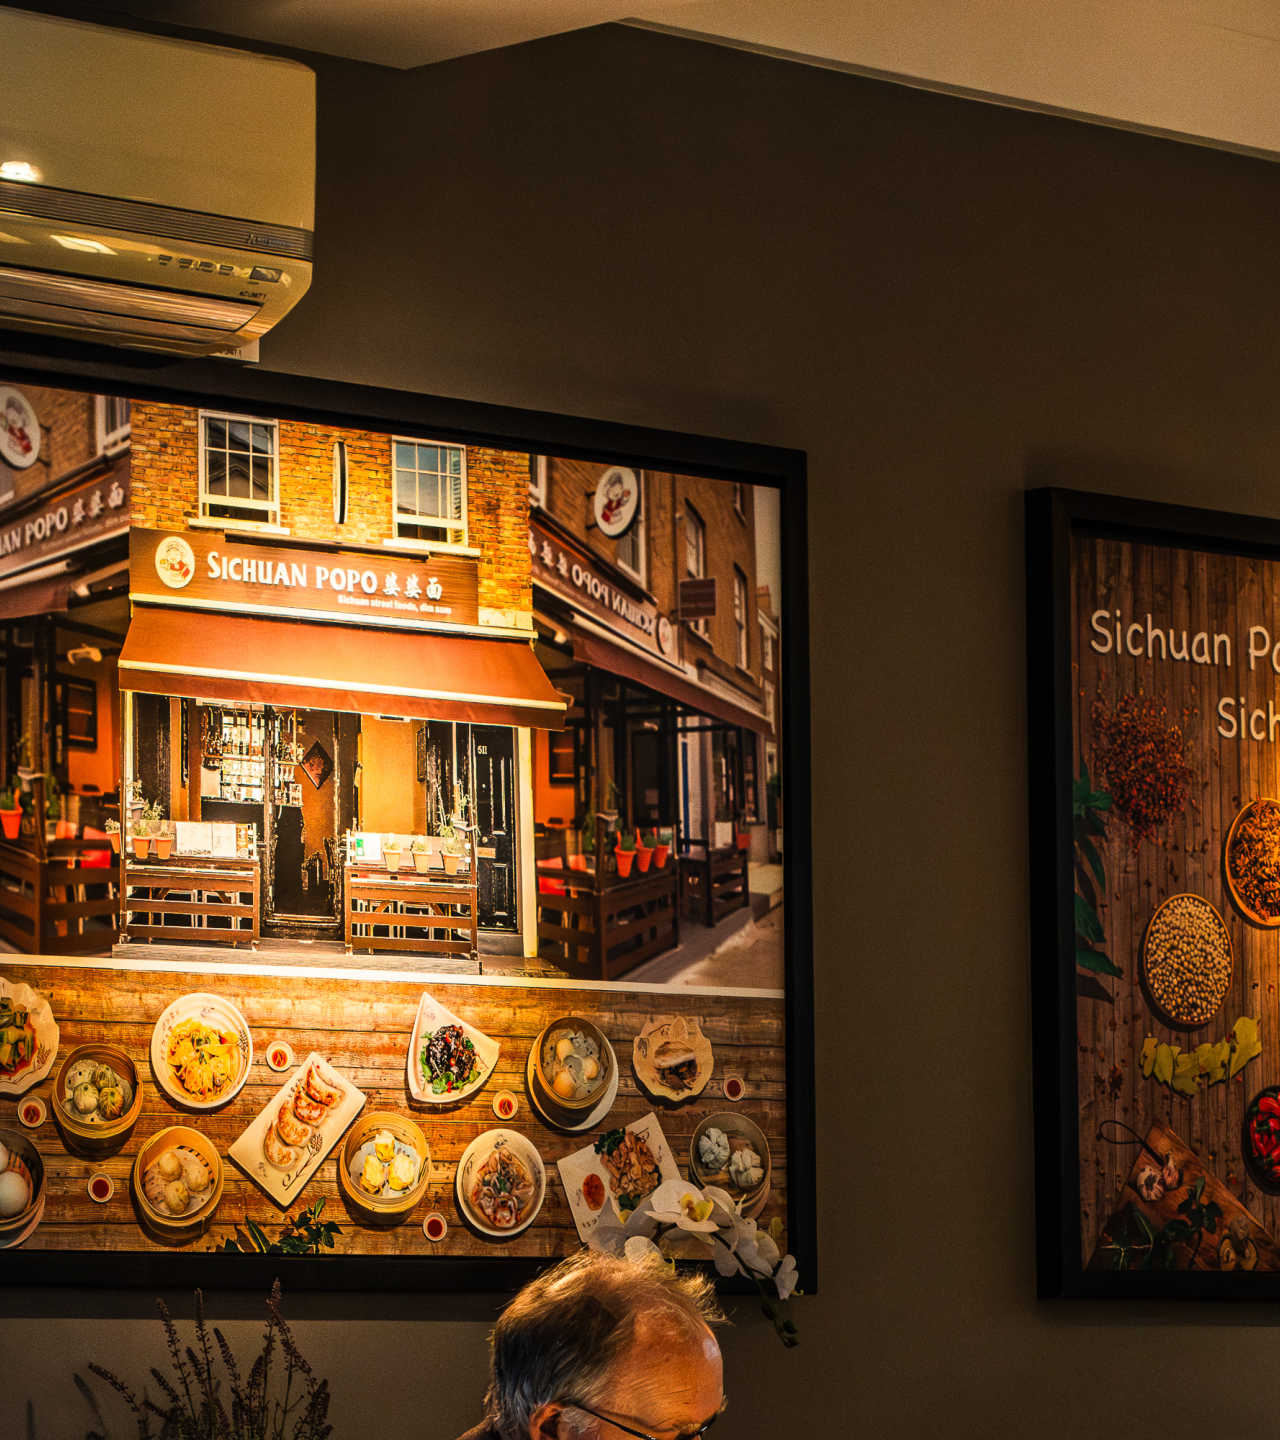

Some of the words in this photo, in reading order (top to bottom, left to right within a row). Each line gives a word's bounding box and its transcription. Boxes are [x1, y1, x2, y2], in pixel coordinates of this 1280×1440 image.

[24, 507, 68, 545] POPO
[207, 551, 308, 589] SICHUAN
[316, 566, 378, 595] POPO
[1090, 609, 1232, 667] Sichuan
